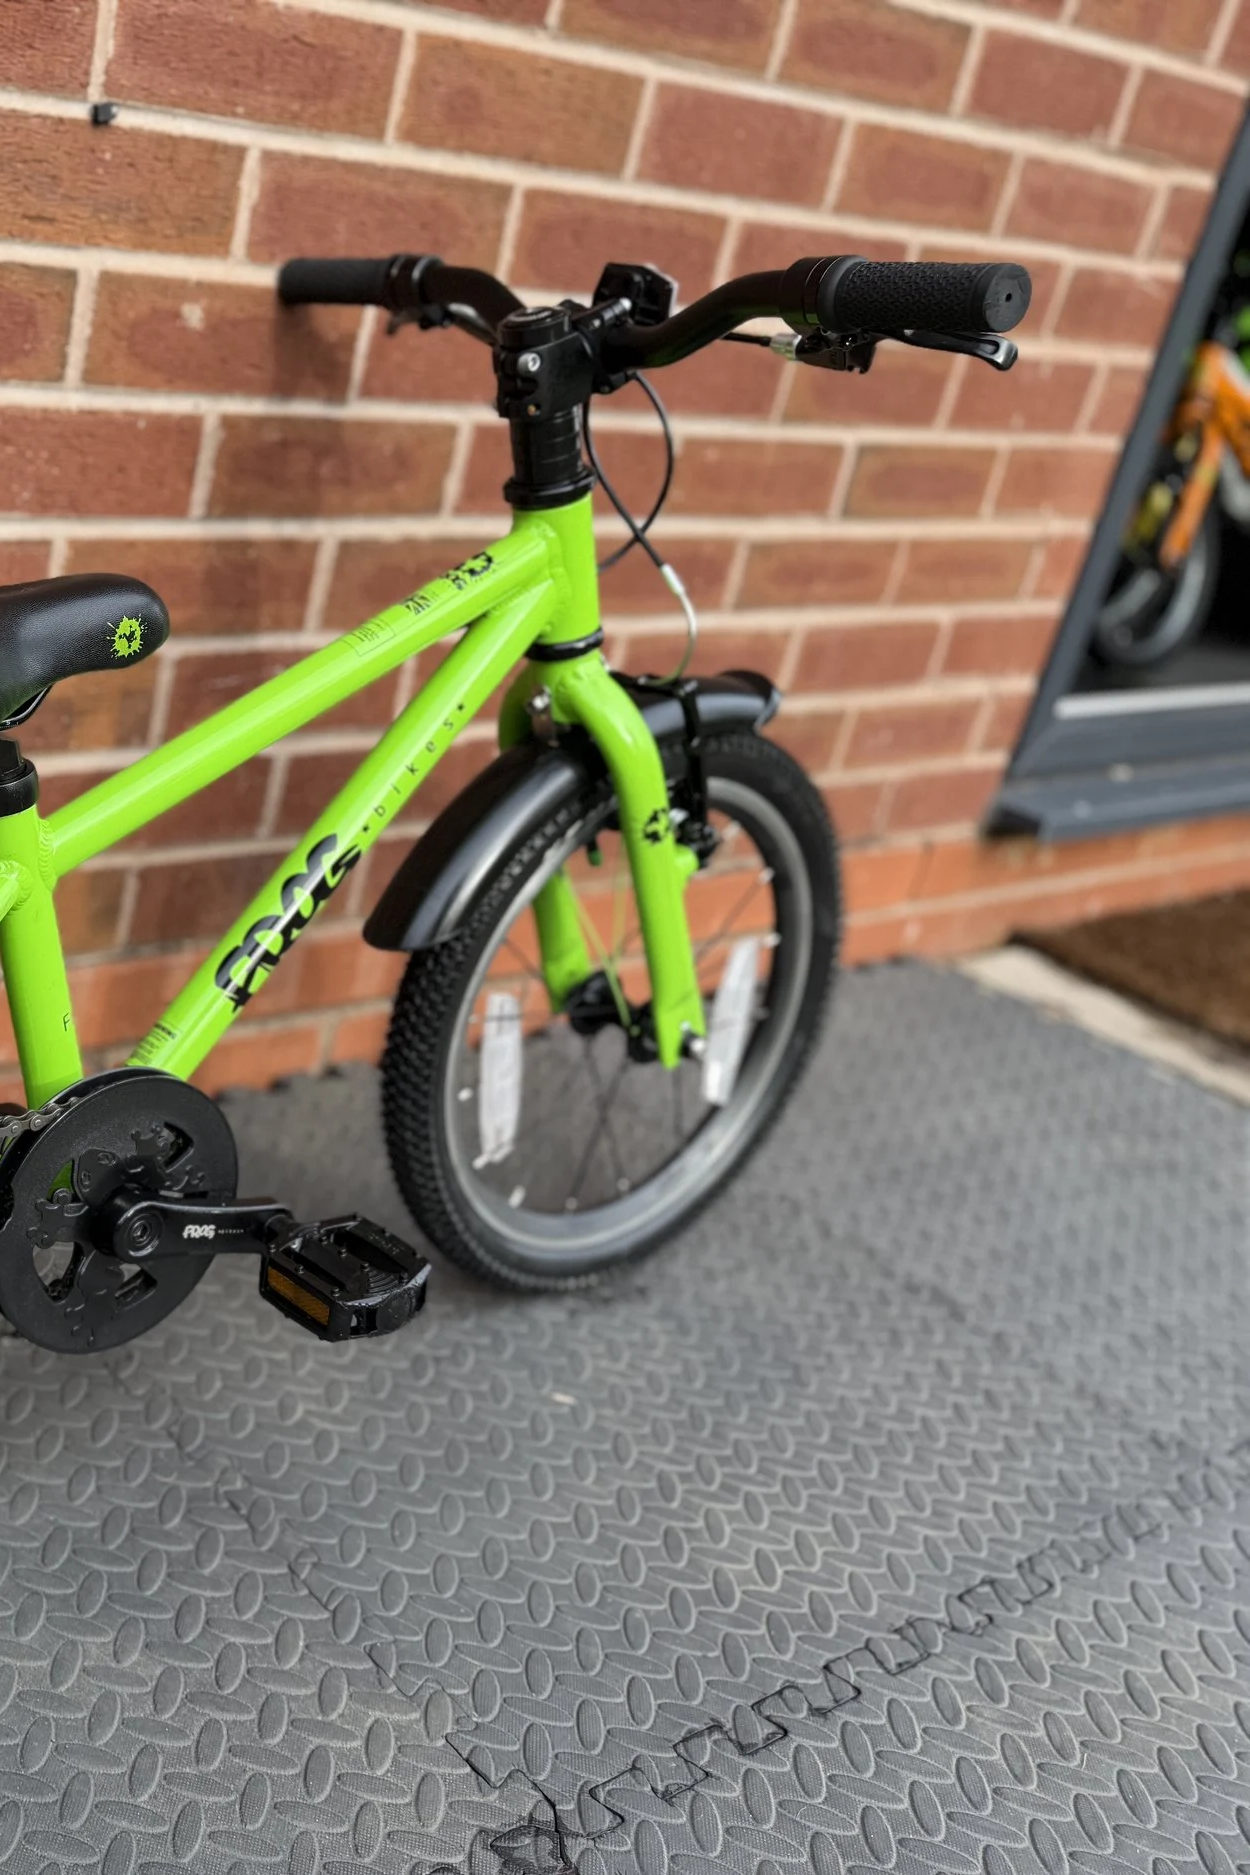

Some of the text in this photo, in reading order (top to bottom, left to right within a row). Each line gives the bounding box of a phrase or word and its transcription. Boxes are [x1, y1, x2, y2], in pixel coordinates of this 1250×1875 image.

[373, 718, 454, 817] bikes
[214, 832, 363, 1014] FROG
[182, 1224, 217, 1239] FROG
